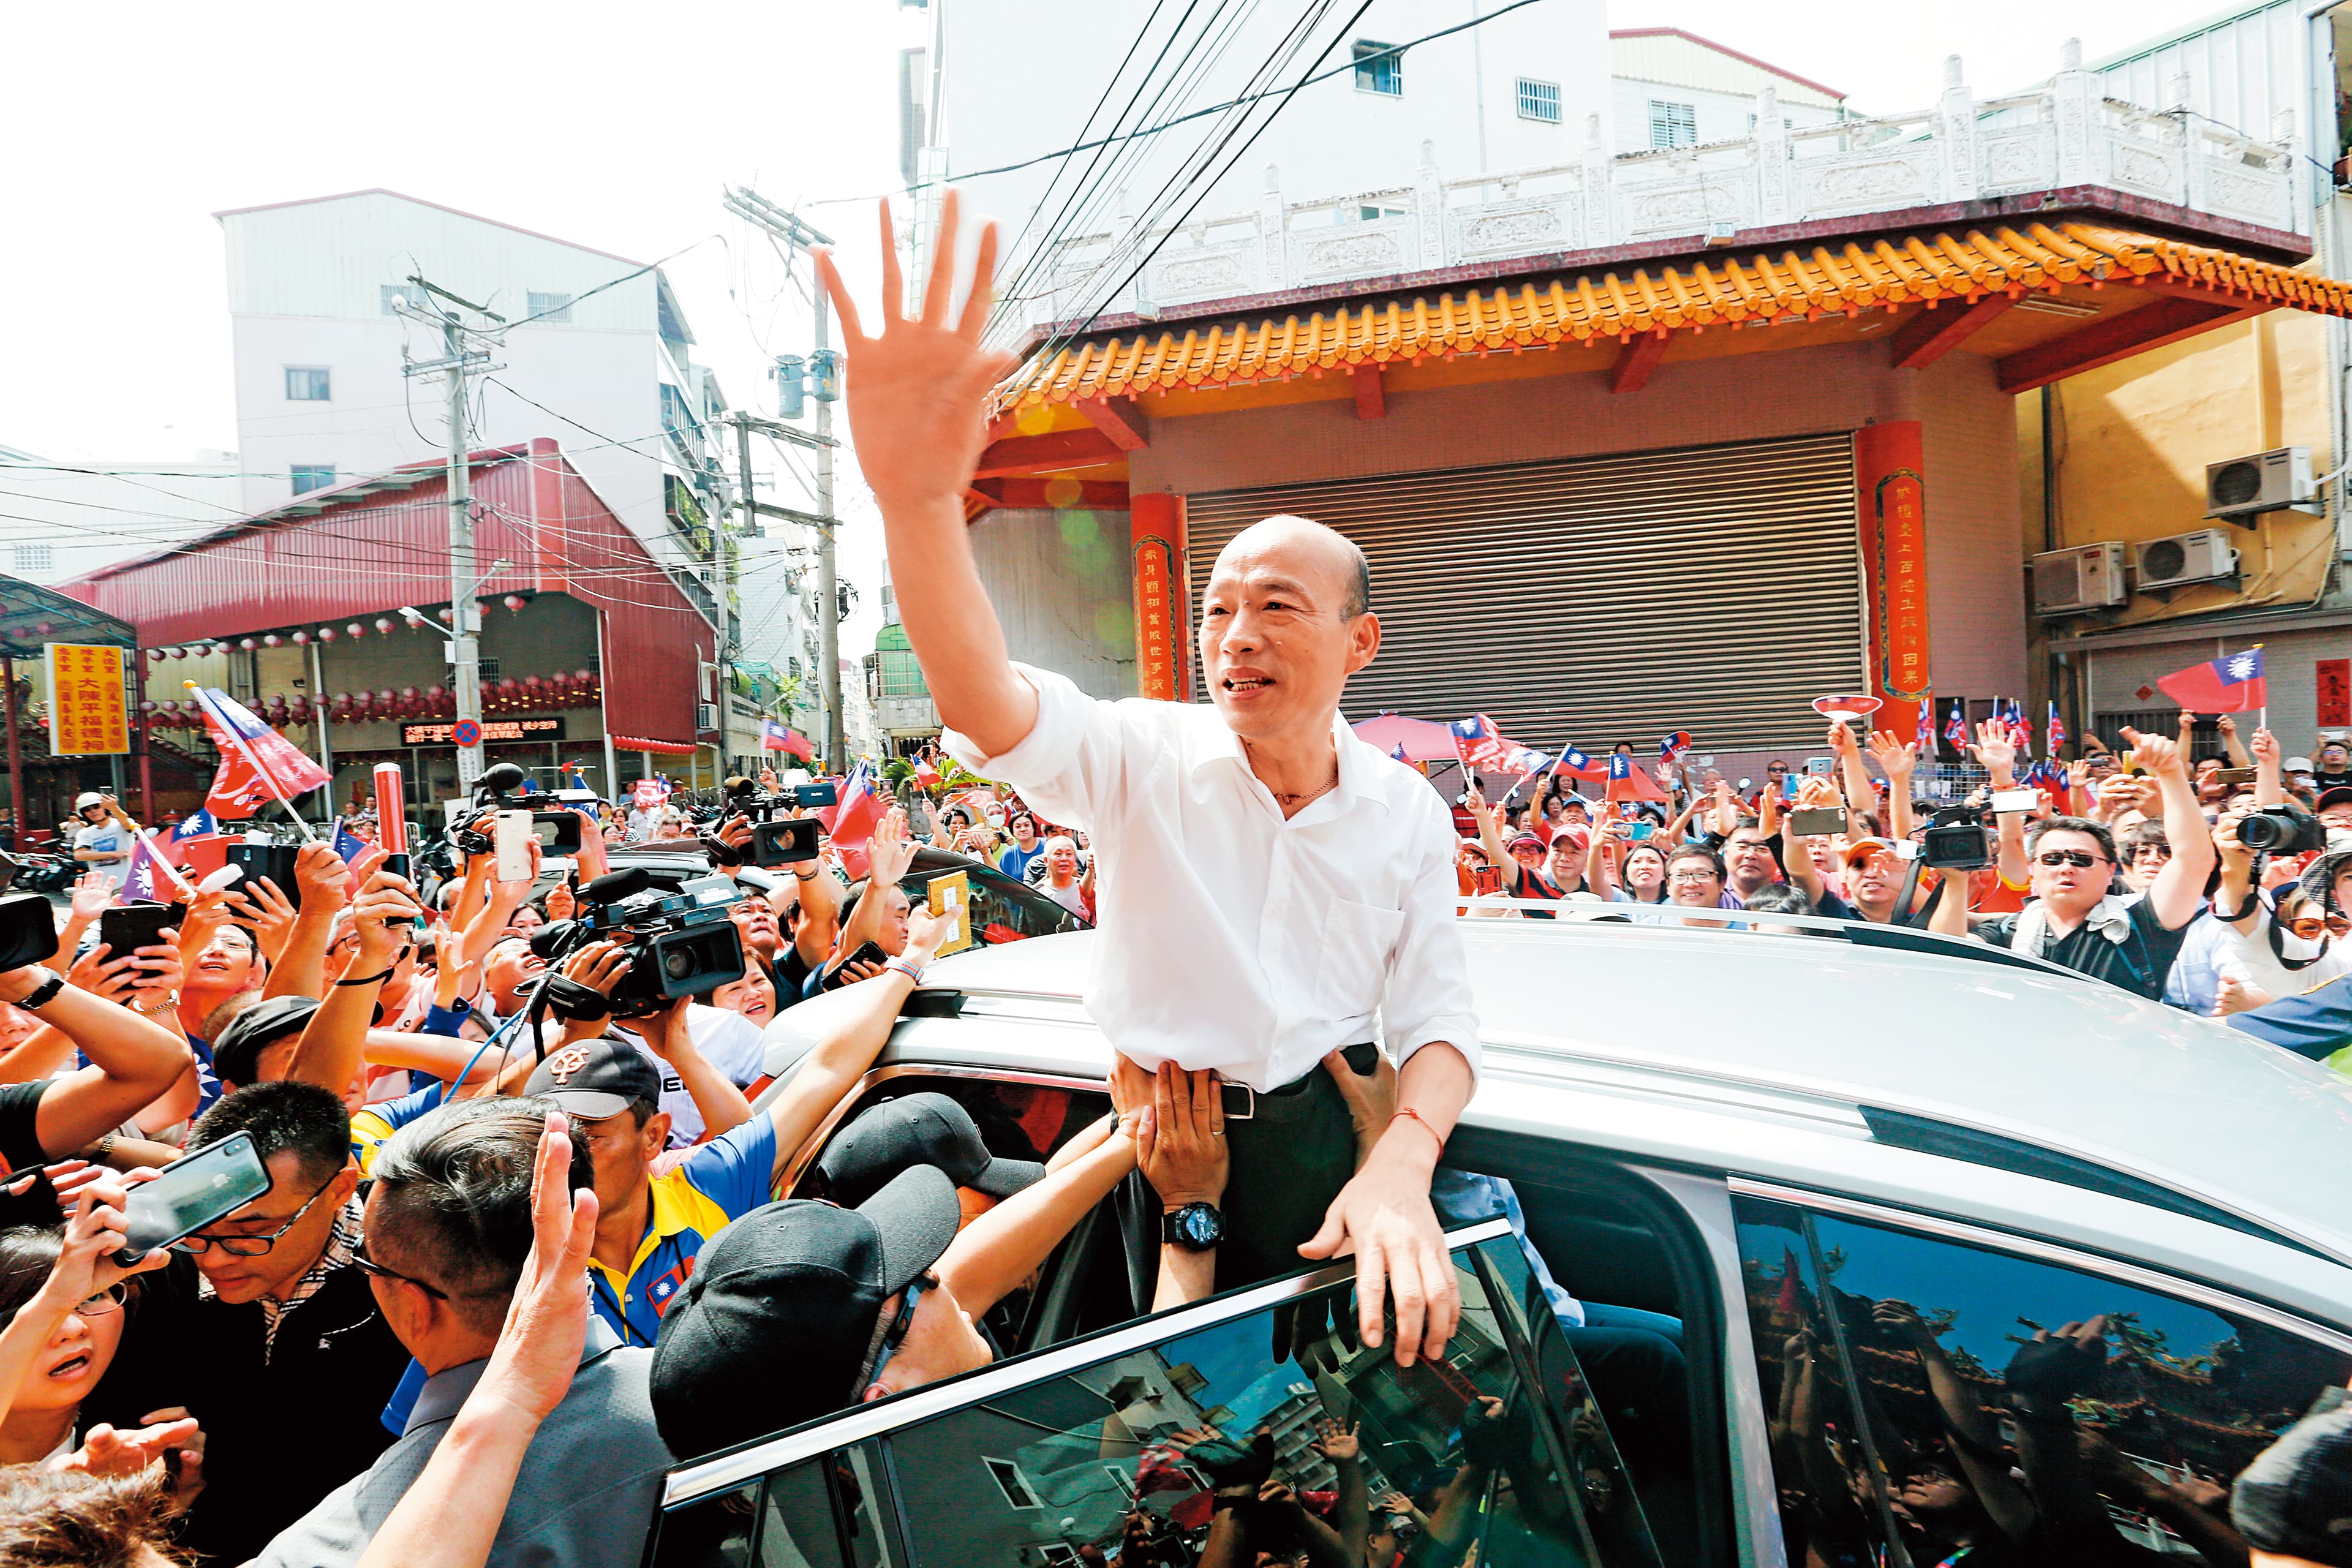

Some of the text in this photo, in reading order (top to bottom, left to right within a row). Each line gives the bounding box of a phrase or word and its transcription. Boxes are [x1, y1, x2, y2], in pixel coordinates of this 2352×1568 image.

[77, 678, 105, 751] 大陳平福德祠
